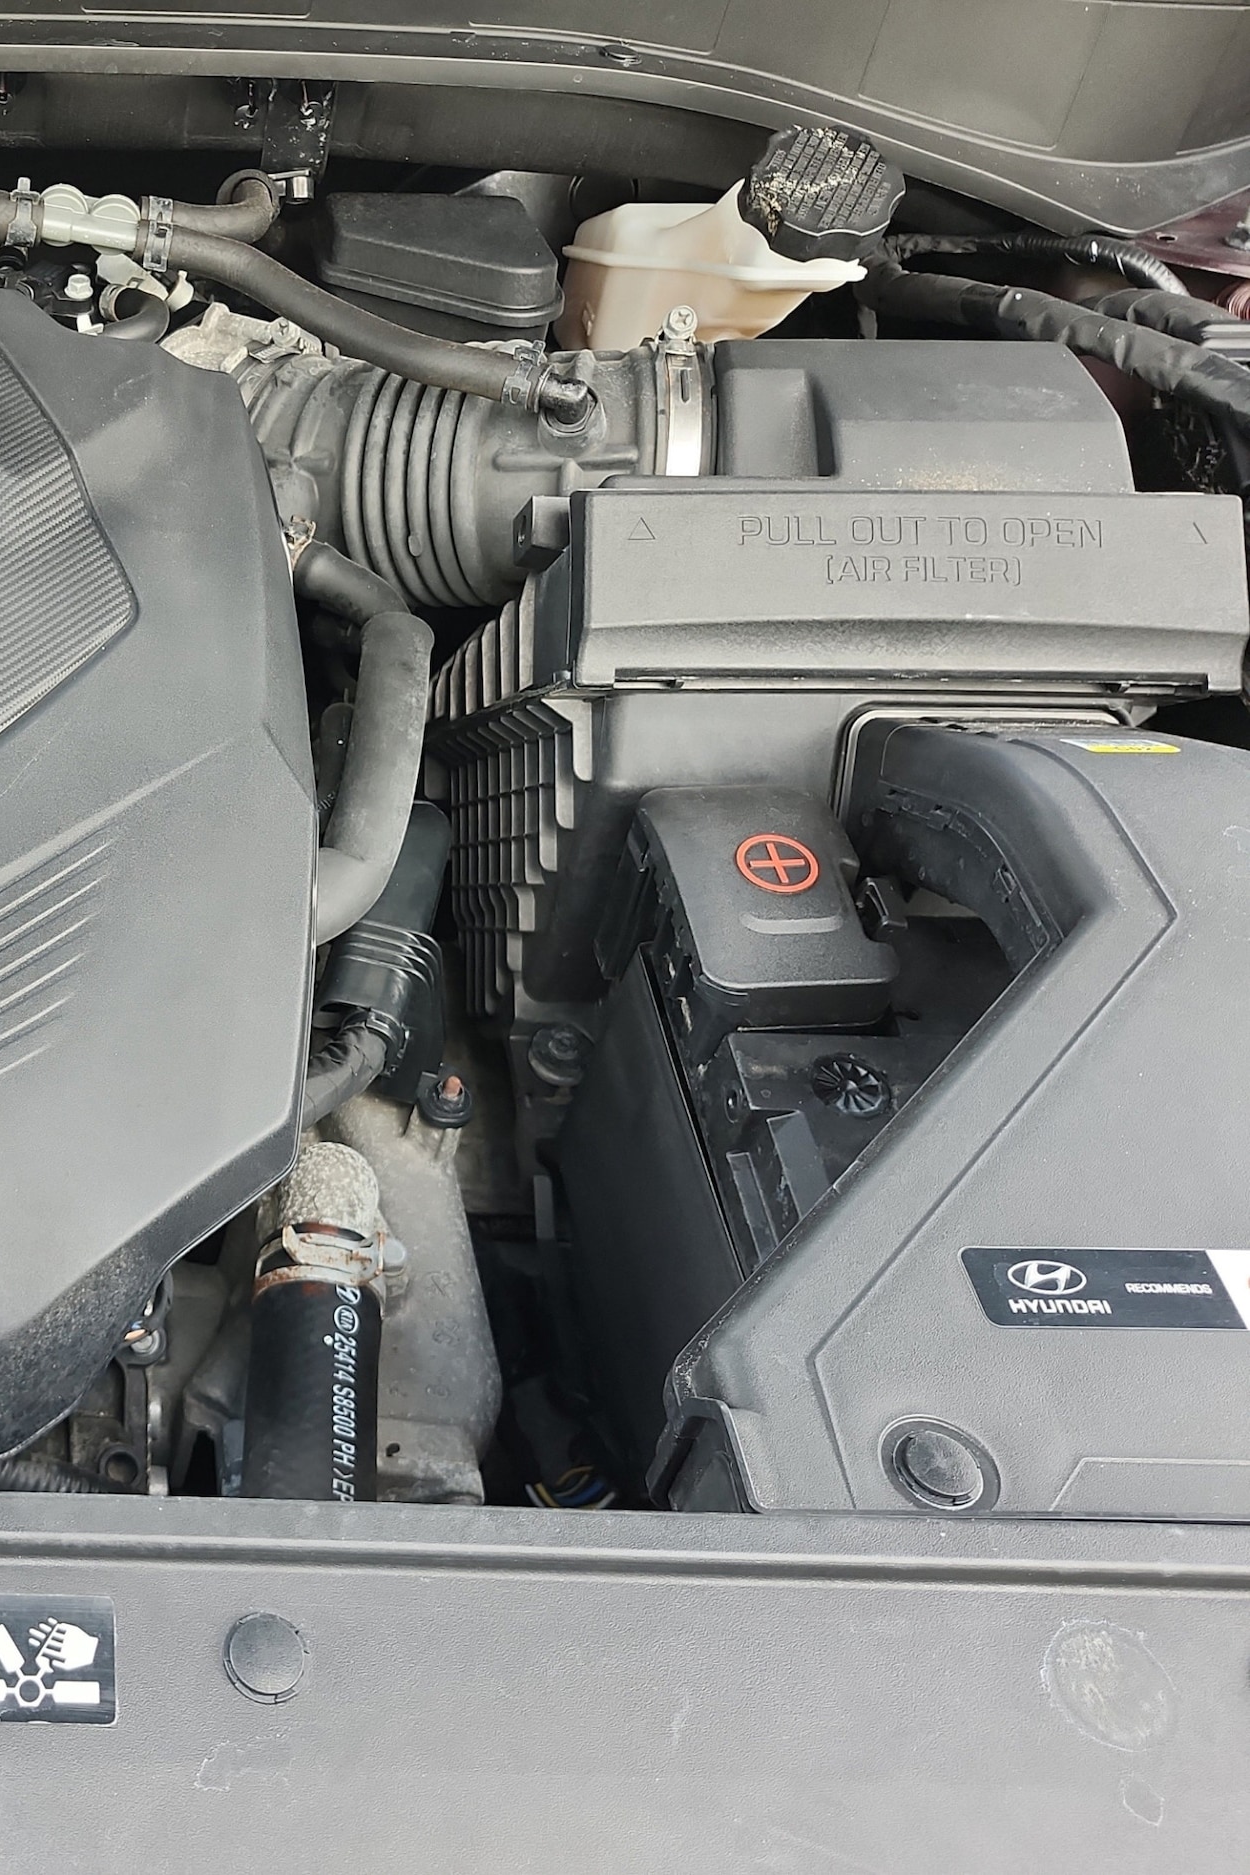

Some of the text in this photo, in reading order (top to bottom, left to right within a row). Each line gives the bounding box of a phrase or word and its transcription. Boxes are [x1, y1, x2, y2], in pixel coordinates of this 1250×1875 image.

[736, 515, 1103, 549] PULL OUT TO OPEN
[825, 554, 1022, 586] (AIR FILTER)
[1124, 1282, 1213, 1295] RECOMMENDS
[1008, 1298, 1113, 1315] HYUNDAI
[333, 1332, 357, 1383] 25414
[332, 1384, 356, 1438] S8500
[332, 1438, 355, 1467] PH
